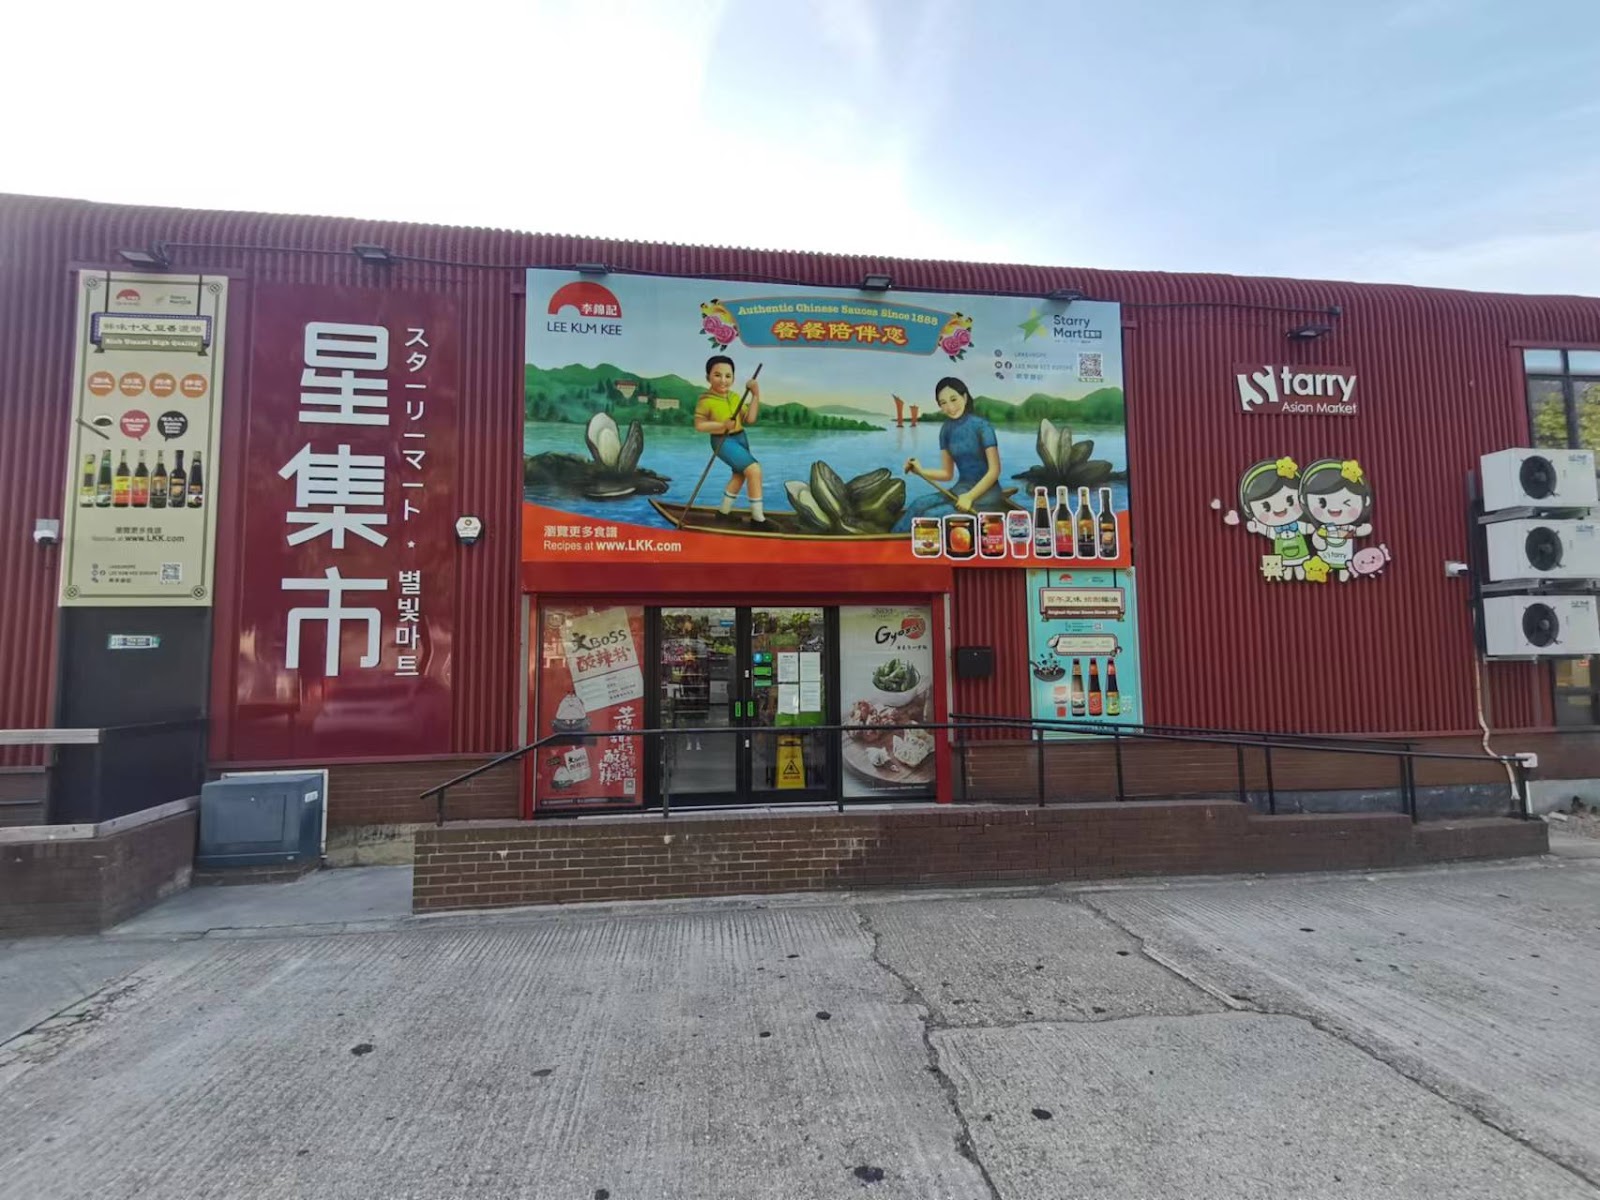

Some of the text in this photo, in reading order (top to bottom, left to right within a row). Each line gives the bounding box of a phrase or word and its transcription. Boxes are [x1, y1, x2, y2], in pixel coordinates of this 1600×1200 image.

[738, 304, 939, 326] Authentic Chinese Sauces Since 1888
[1053, 314, 1090, 328] Starry
[547, 321, 622, 336] LEE KUM KEE
[1053, 327, 1082, 339] Mart
[1281, 401, 1358, 415] Asian Market
[402, 327, 429, 522] スターリーマート
[543, 539, 682, 552] Recipes at www.LKK.com
[395, 570, 421, 677] 별빛마트
